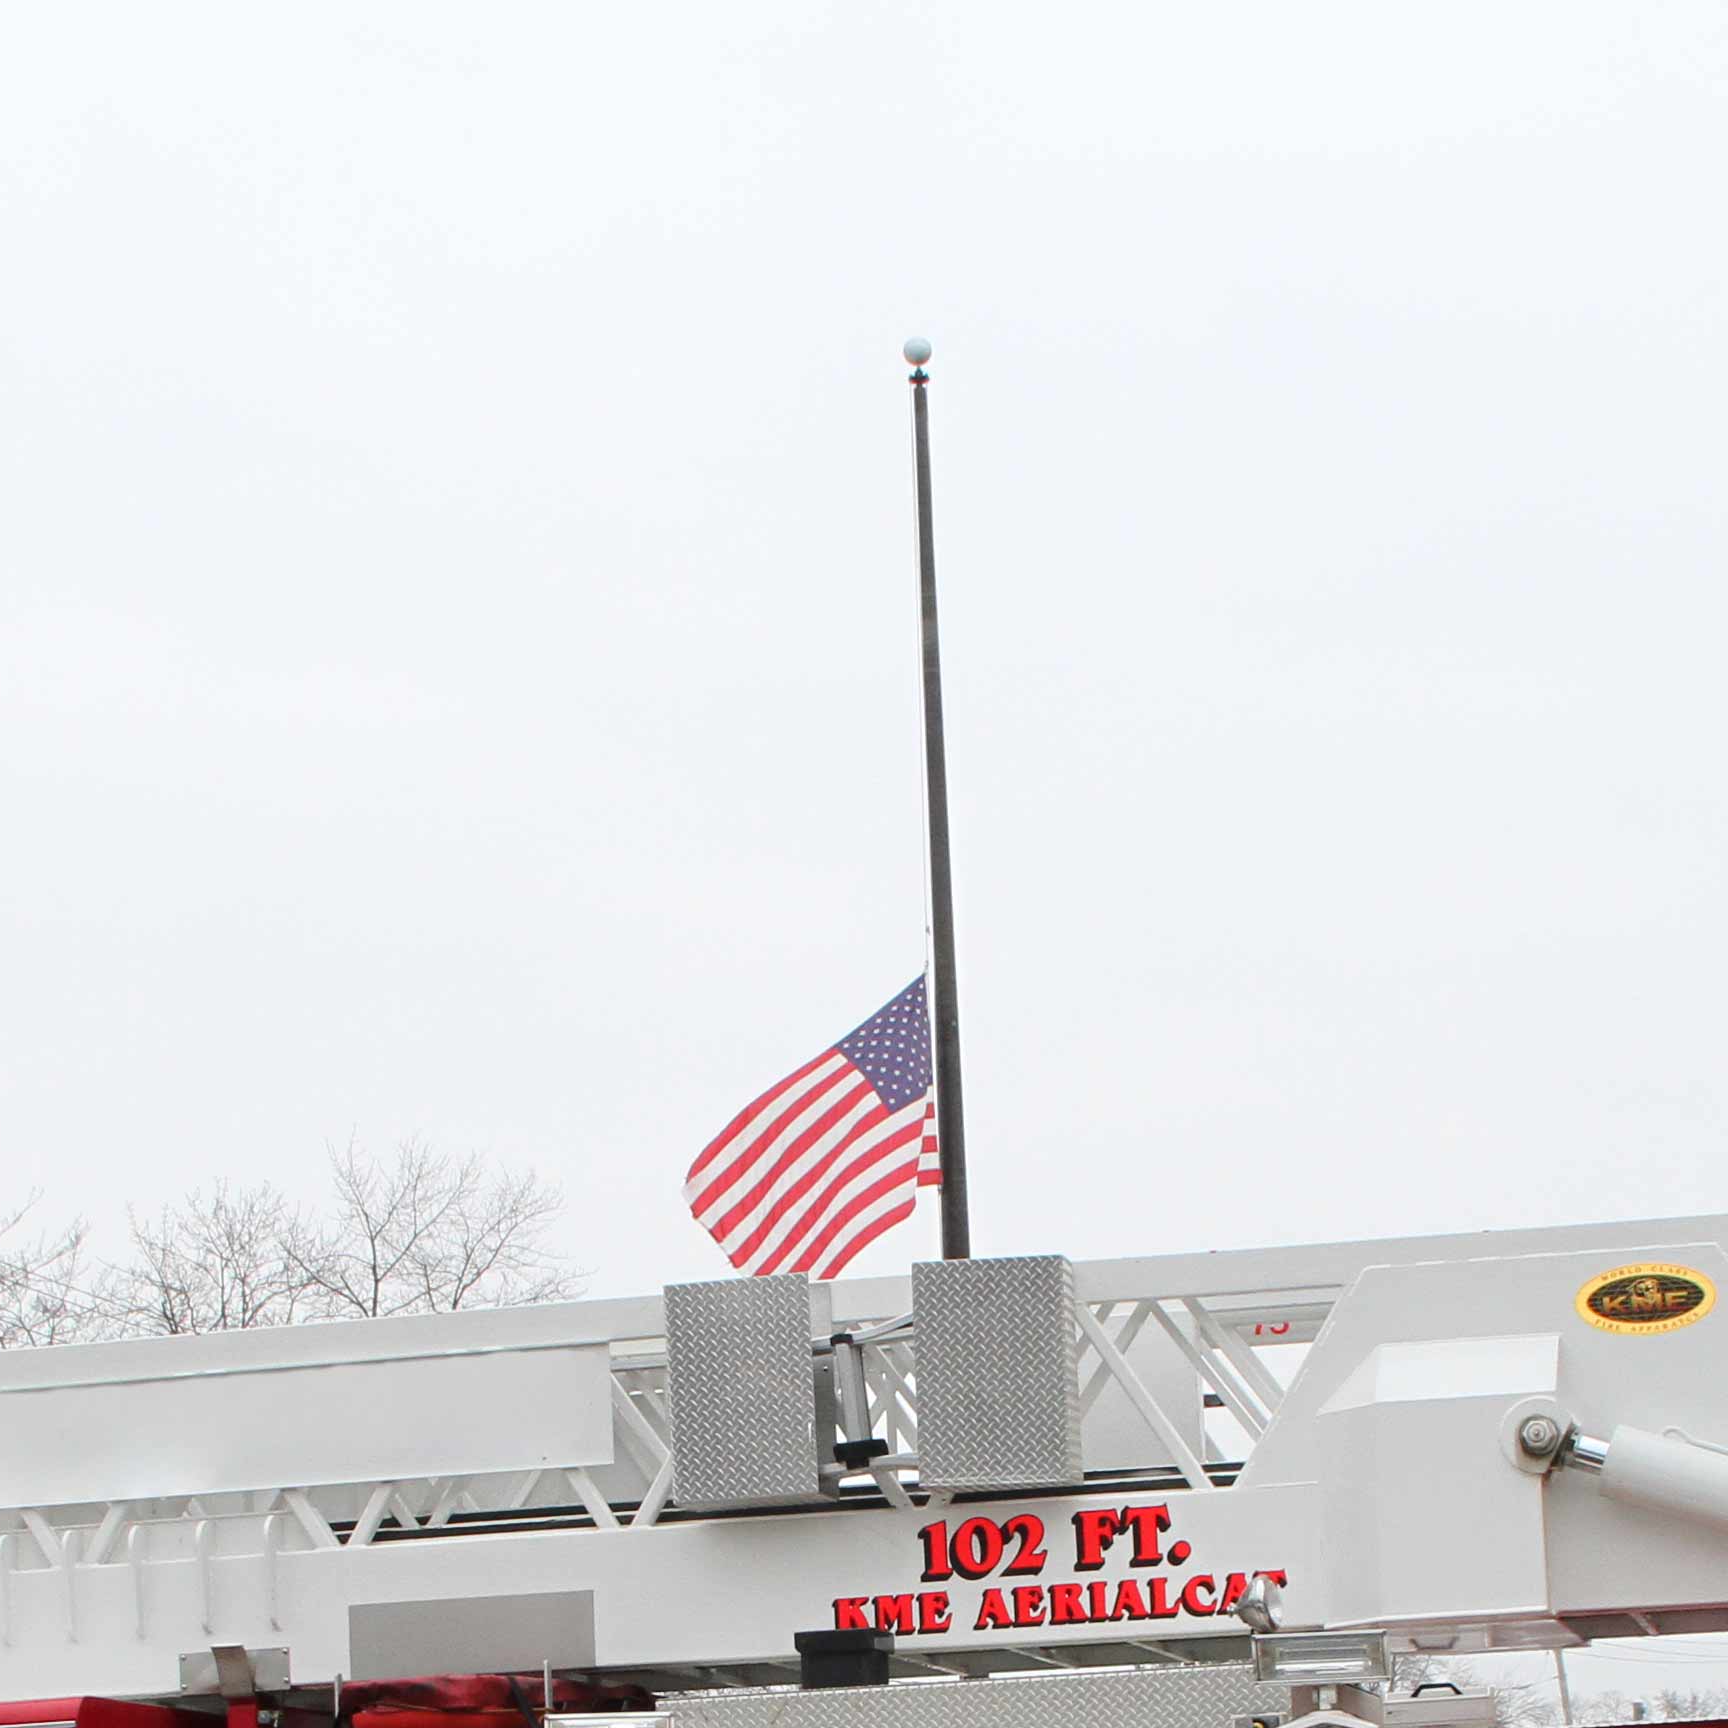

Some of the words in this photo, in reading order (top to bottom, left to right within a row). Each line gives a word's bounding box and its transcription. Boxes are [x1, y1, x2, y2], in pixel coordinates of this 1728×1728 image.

[1600, 1265, 1643, 1281] WORLD
[1601, 1289, 1690, 1314] KME
[918, 1513, 1048, 1582] 102
[1071, 1503, 1191, 1572] FT.
[833, 1585, 953, 1636] KME
